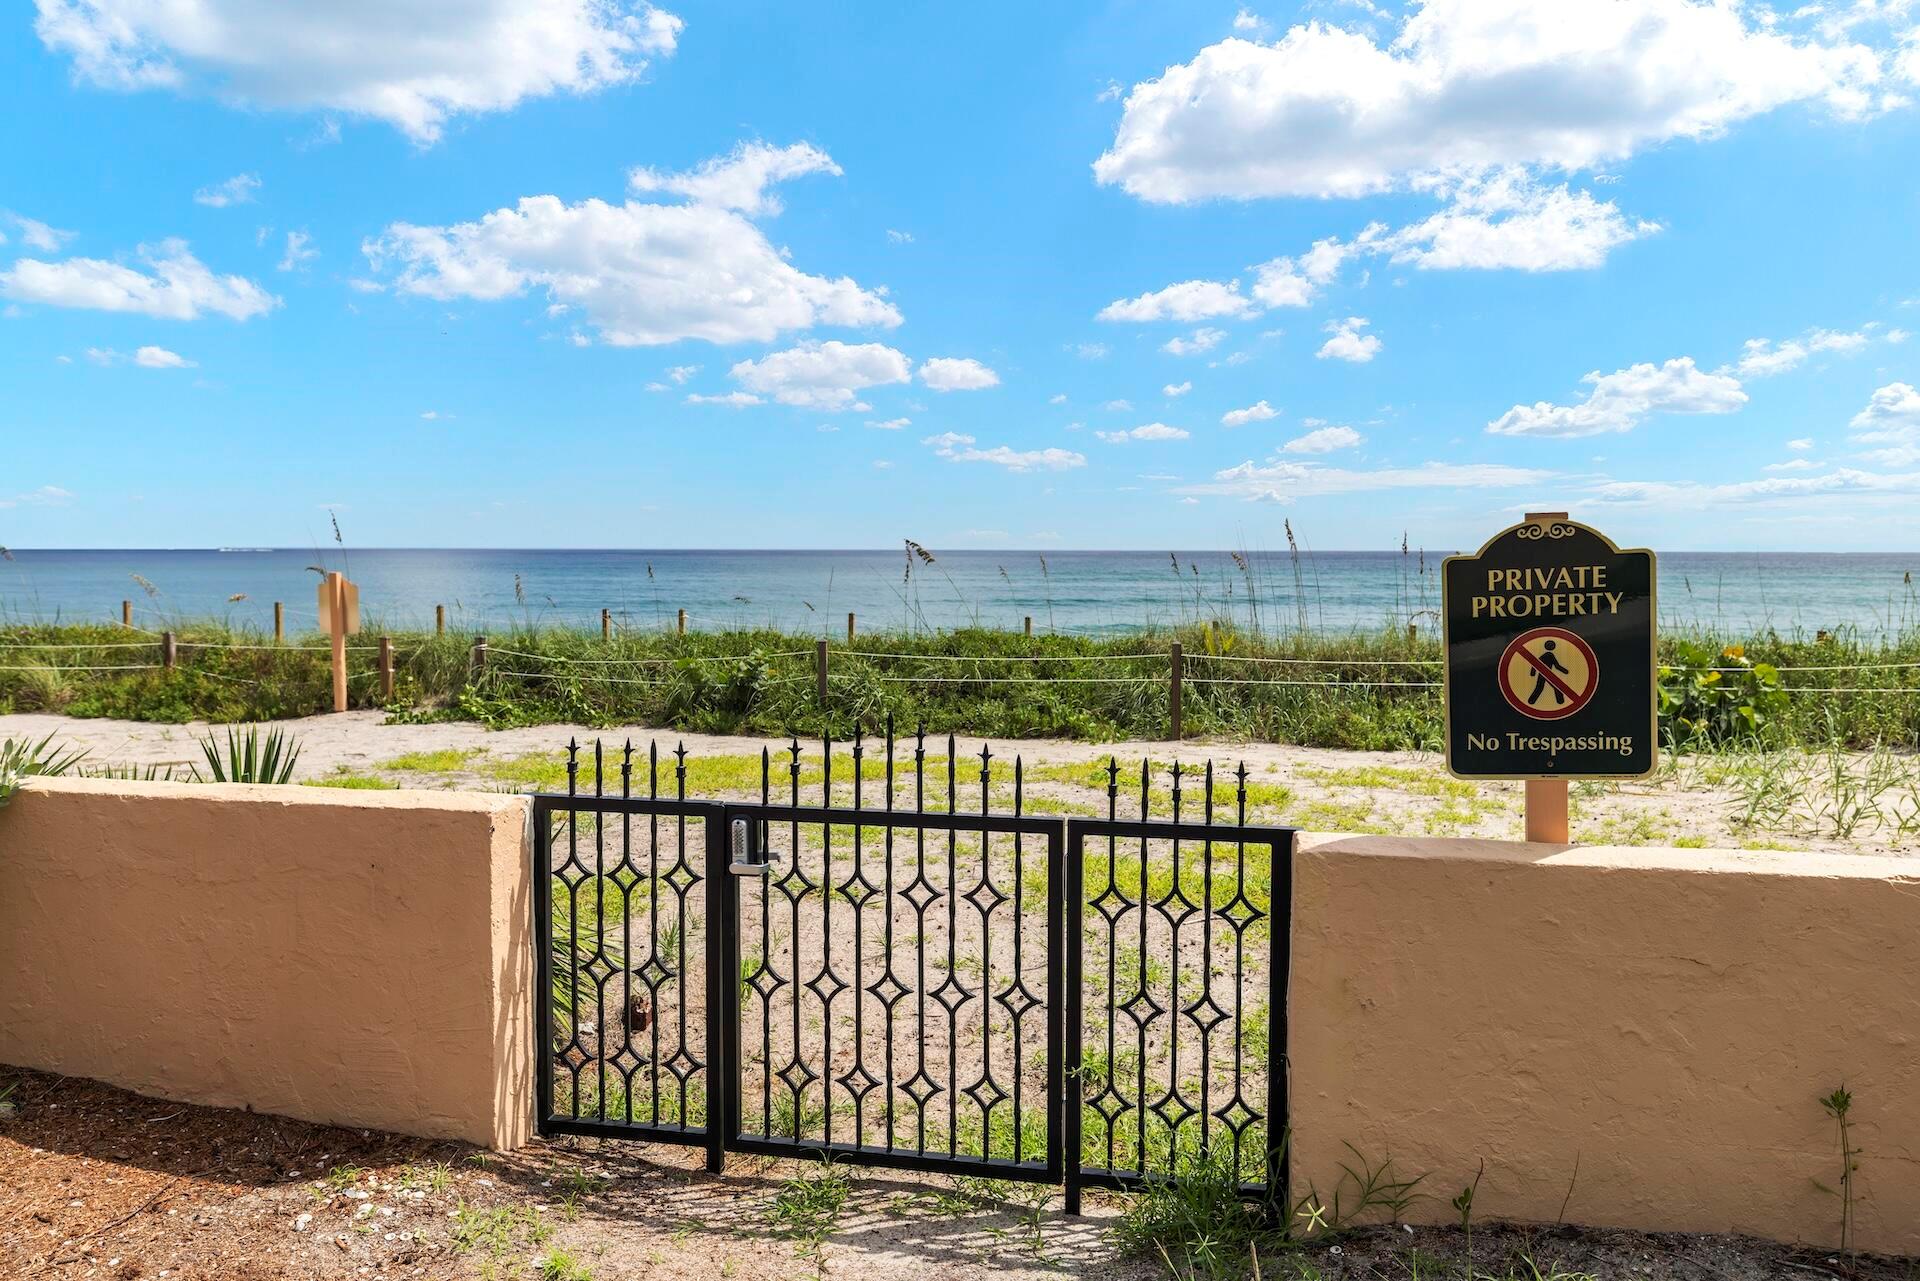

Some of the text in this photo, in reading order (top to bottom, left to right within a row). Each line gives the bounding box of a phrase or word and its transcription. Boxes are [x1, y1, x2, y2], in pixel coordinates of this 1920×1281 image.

[1488, 566, 1607, 591] PRIVATE
[1472, 592, 1624, 618] PROPERTY
[1467, 731, 1633, 756] No Trespassing
